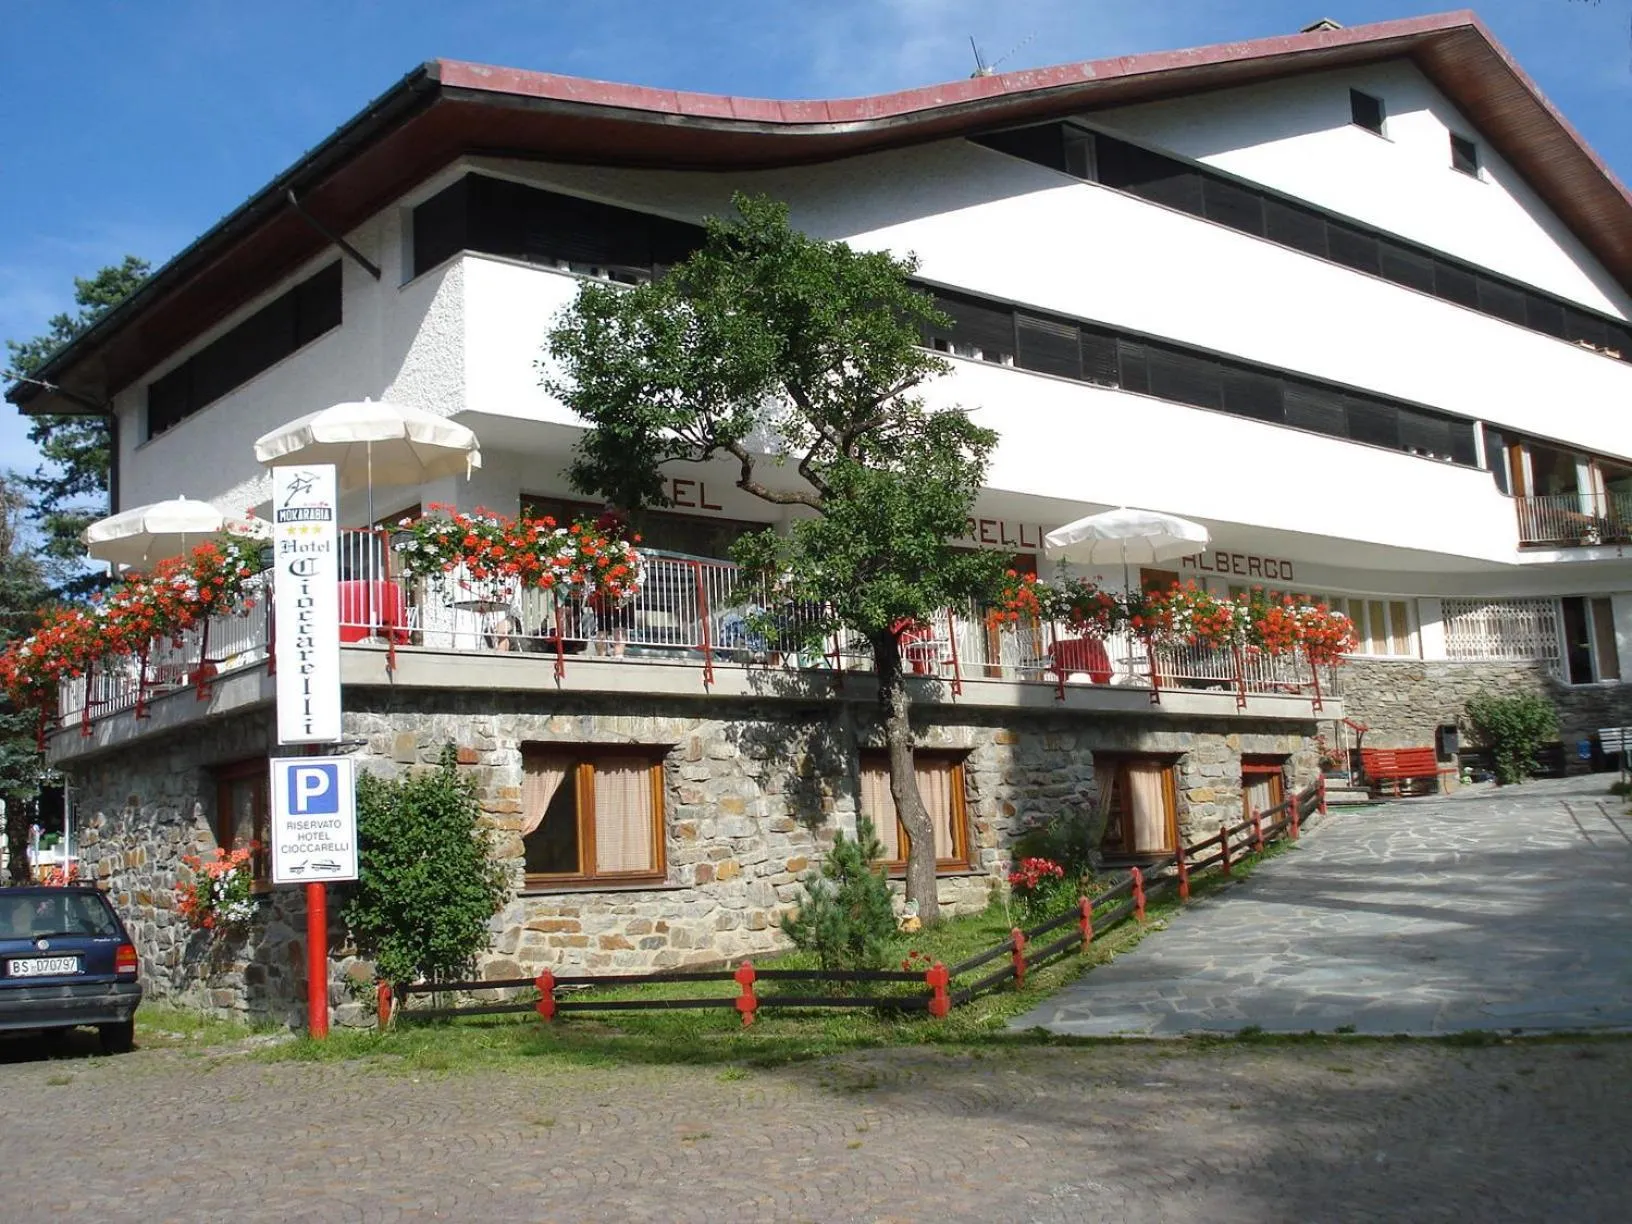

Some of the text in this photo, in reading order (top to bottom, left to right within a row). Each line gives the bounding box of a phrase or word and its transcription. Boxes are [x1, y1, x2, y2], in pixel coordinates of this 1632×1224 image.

[279, 508, 330, 521] MOKARABIA
[280, 540, 330, 558] Hotel
[1182, 551, 1293, 581] ALBERGO
[288, 557, 320, 735] Cioccarelli
[296, 768, 330, 812] P
[286, 819, 342, 830] RISERVATO
[297, 831, 331, 842] HOTEL
[280, 842, 349, 854] CIOCCARELLI
[13, 961, 29, 973] BS
